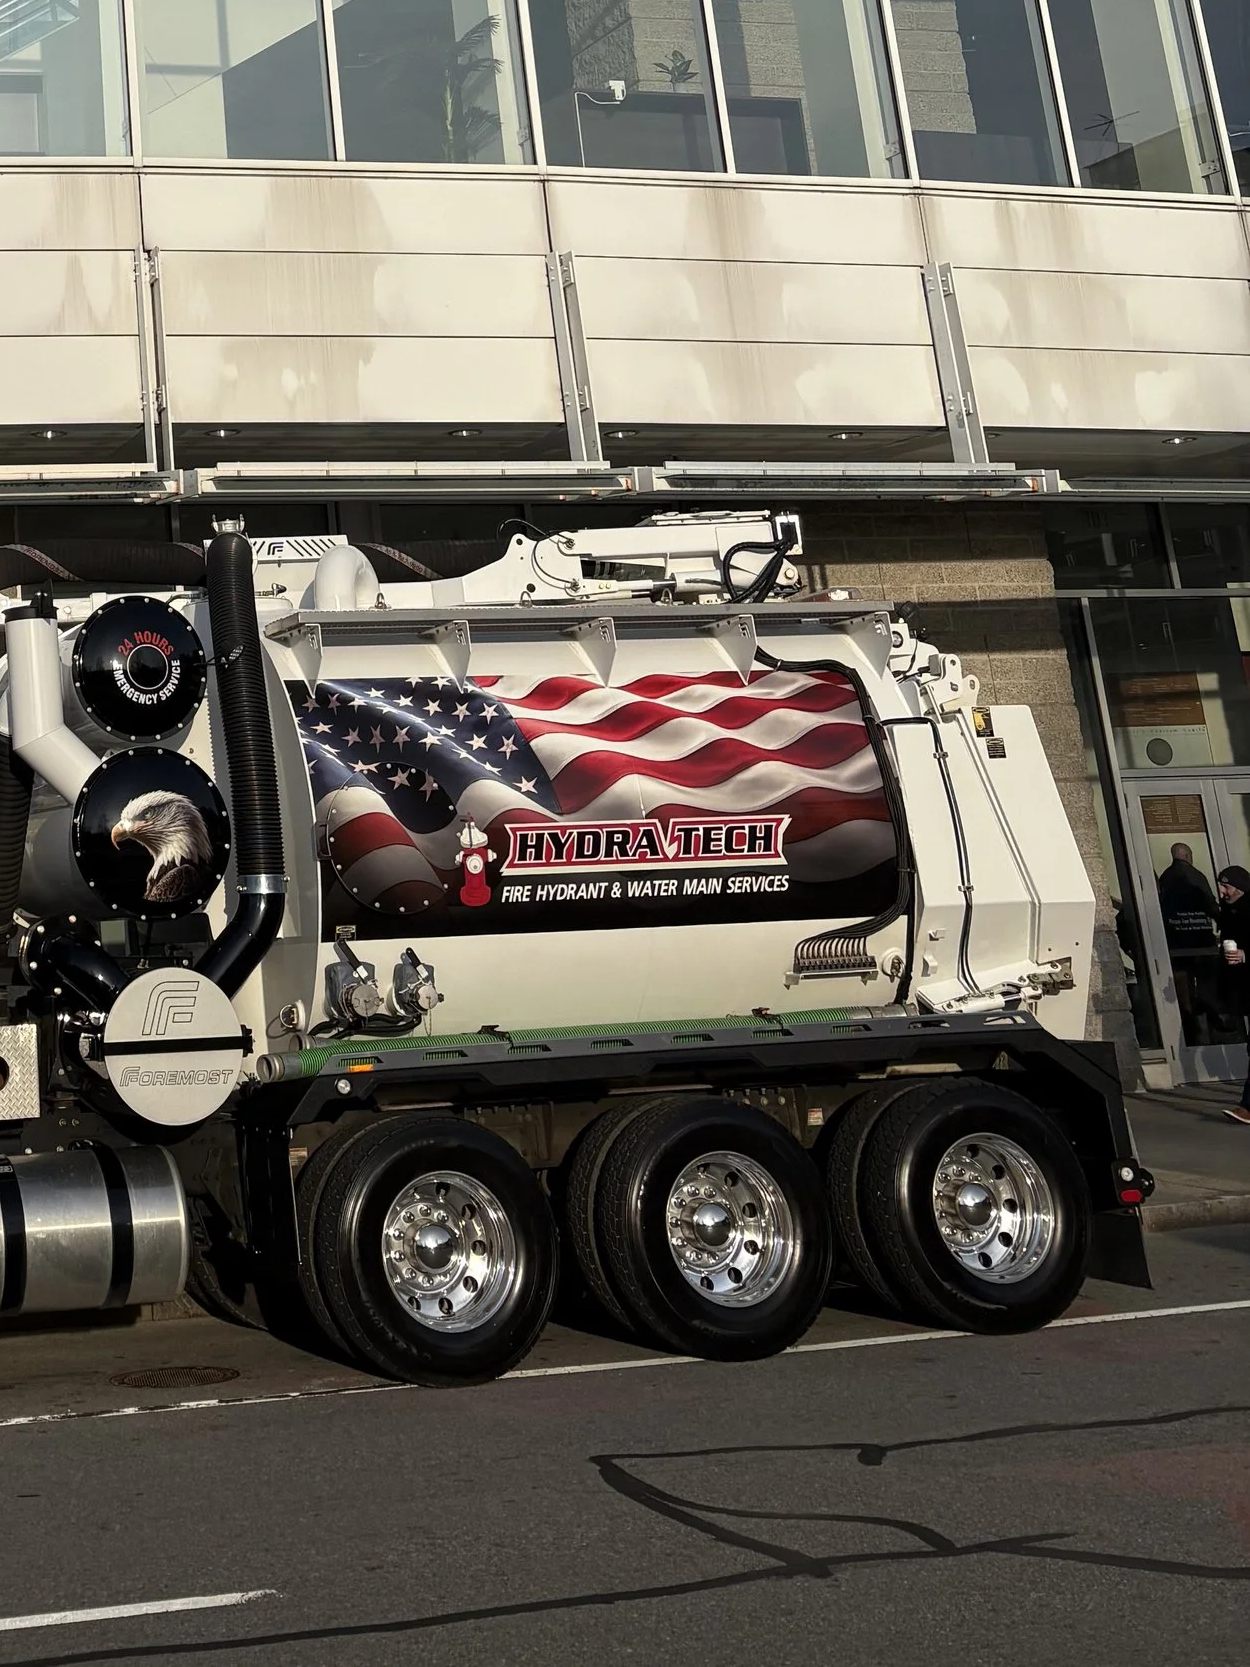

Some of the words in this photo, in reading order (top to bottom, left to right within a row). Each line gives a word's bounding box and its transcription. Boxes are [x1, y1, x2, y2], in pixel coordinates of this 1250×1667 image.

[118, 638, 134, 656] 24
[134, 630, 174, 656] HOURS
[113, 662, 158, 705] EMERGENCY
[159, 659, 180, 701] SERVICE
[502, 885, 532, 903] FIRE
[535, 882, 608, 901] HYDRANT
[610, 882, 622, 898] &
[627, 880, 678, 898] WATER
[683, 878, 722, 896] MAIN
[726, 875, 790, 894] SERVICES
[120, 1066, 234, 1086] FOREMOST
